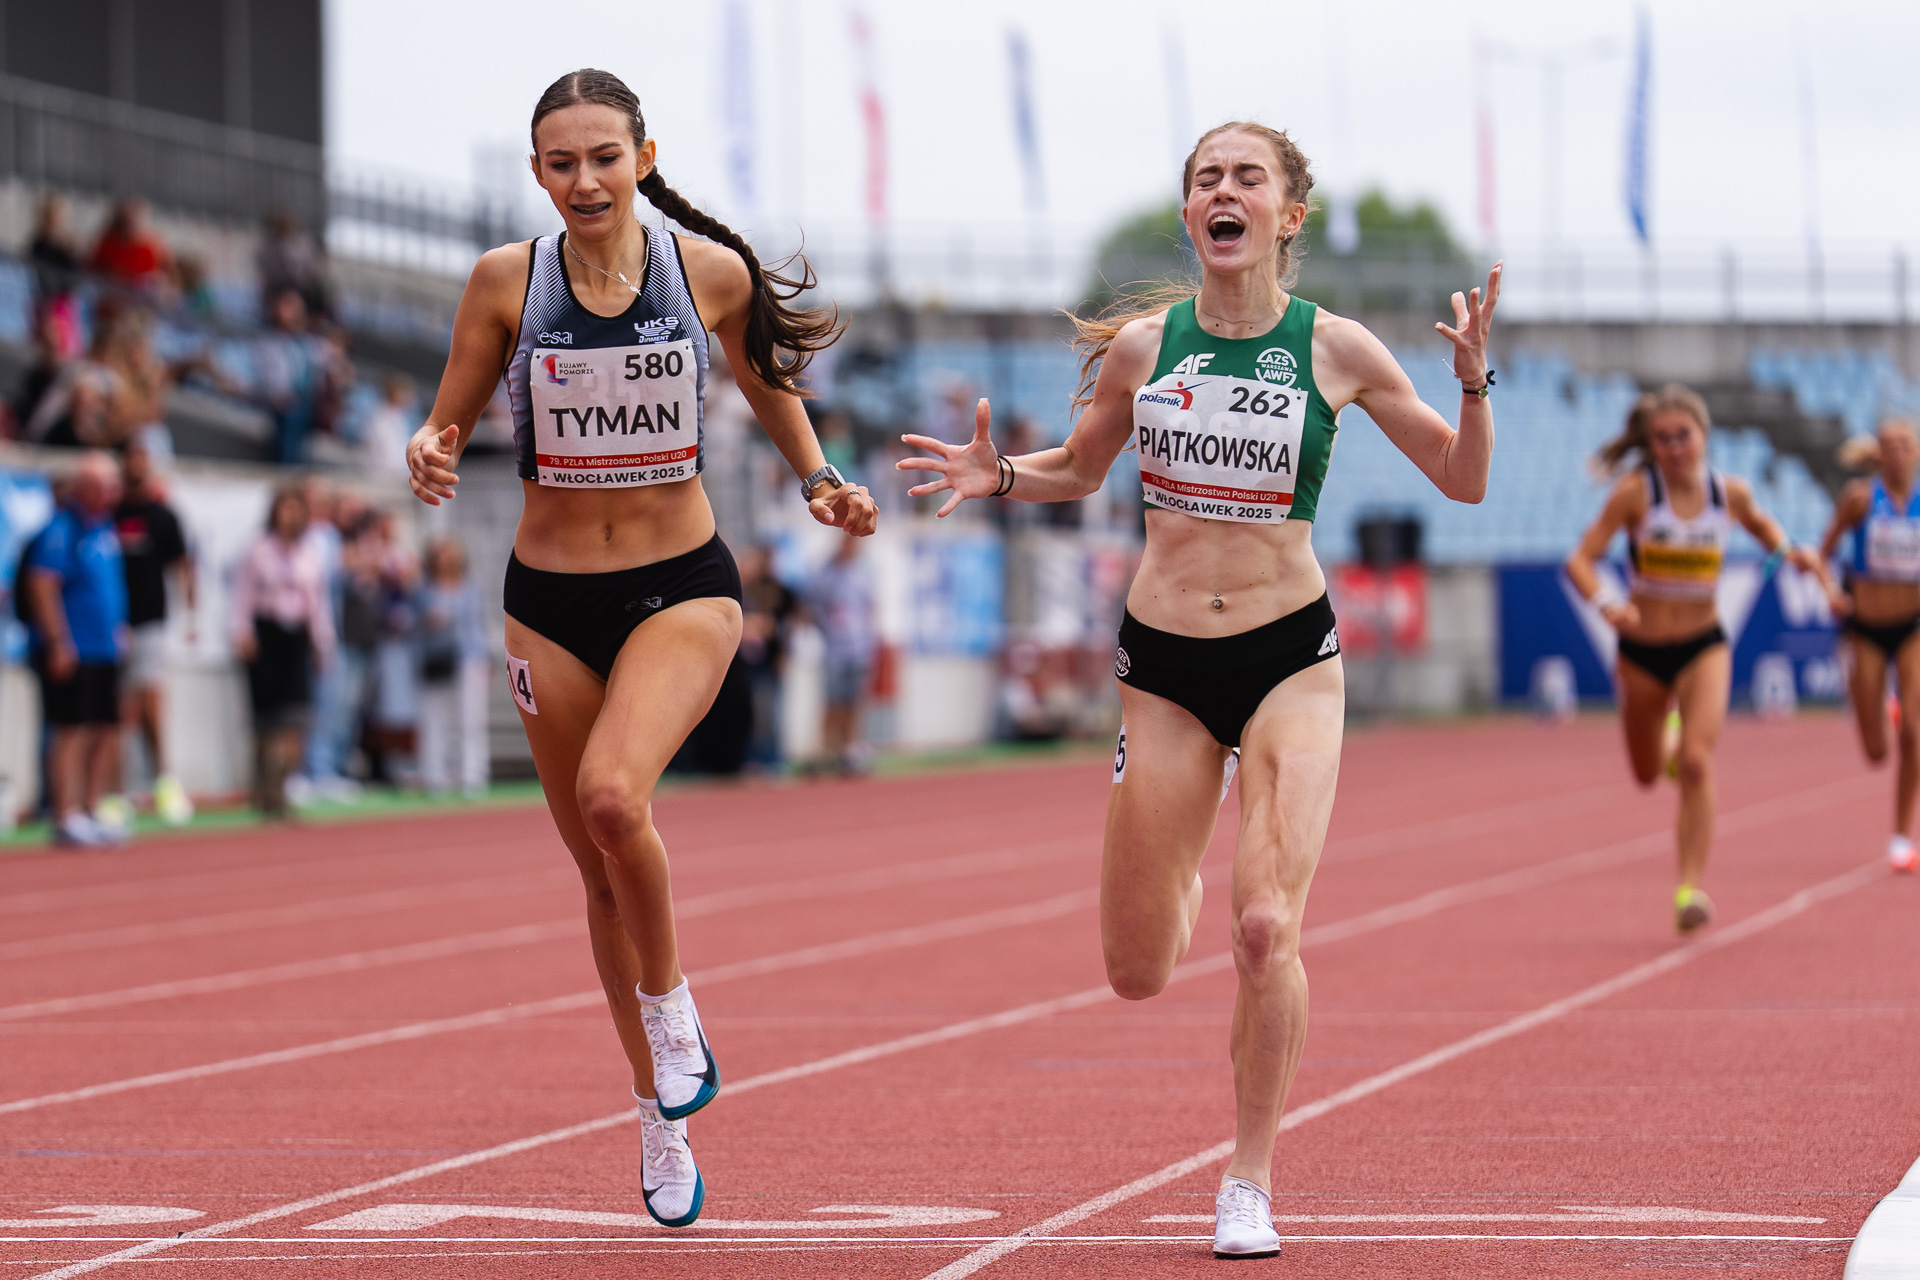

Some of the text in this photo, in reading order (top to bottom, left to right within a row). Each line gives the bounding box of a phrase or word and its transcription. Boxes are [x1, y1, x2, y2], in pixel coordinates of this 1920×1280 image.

[634, 316, 679, 331] UKS
[624, 350, 684, 381] 580
[1172, 353, 1216, 375] 4F
[1261, 363, 1293, 373] WARSZAWA
[1264, 353, 1290, 366] AZS
[1262, 369, 1291, 382] AWF
[1138, 392, 1182, 407] polanik
[1228, 386, 1290, 418] 262
[549, 401, 680, 437] TYMAN
[550, 450, 687, 466] 79. PZLA Mistrzostwa Polski U20
[1139, 426, 1291, 474] PIĄTKOWSKA
[553, 466, 685, 484] WŁOCŁAWEK 2025
[1161, 479, 1176, 491] PZLA
[1177, 483, 1230, 498] Mistrzostwa
[1232, 491, 1259, 501] Polski
[1260, 492, 1278, 502] U20
[1155, 490, 1273, 519] WŁOCŁAWEK 2025
